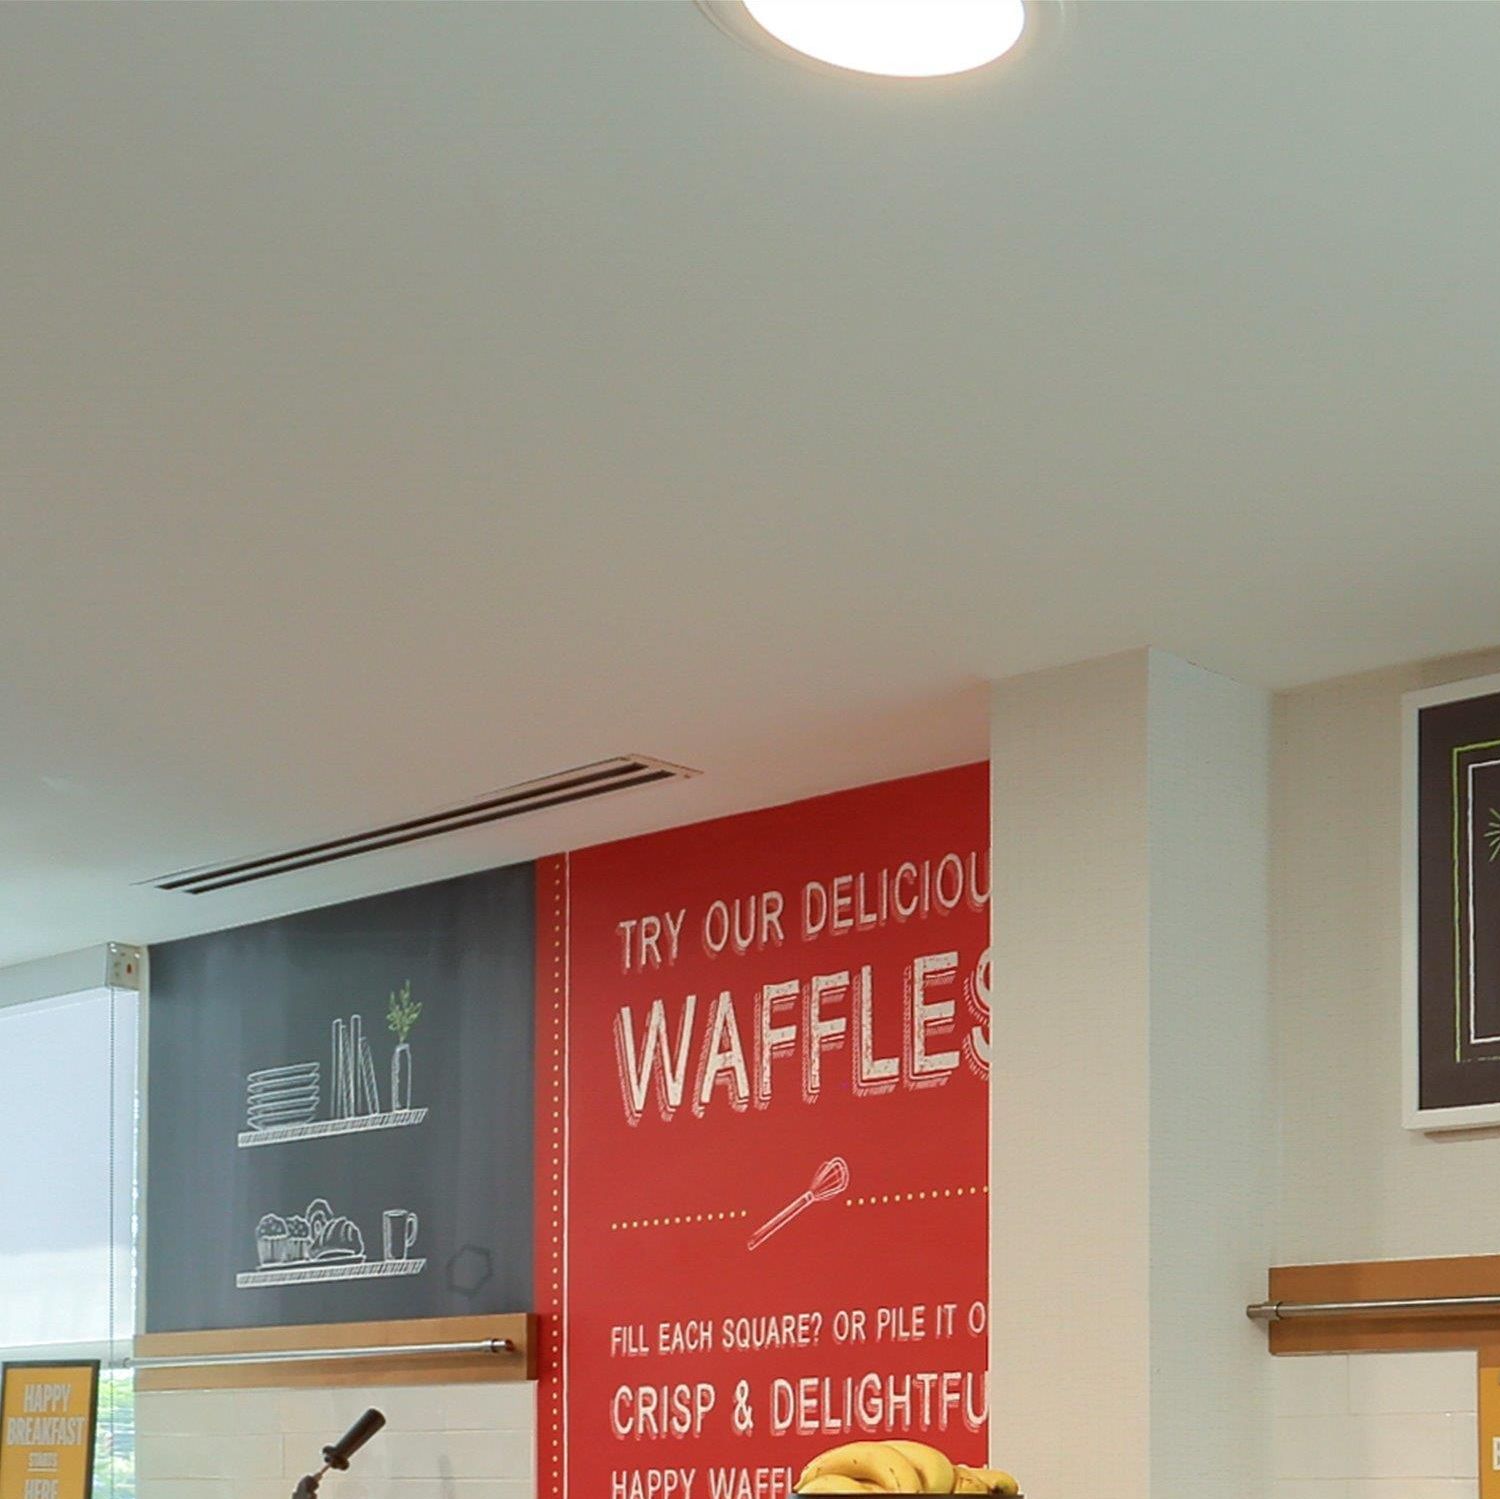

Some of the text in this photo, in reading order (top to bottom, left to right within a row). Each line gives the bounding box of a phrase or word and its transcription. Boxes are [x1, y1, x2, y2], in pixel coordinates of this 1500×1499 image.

[618, 908, 686, 974] TRY
[703, 890, 785, 956] OUR
[610, 1325, 649, 1356] FILL
[658, 1320, 713, 1354] EACH
[722, 1311, 823, 1350] SQUARE?
[832, 1310, 866, 1344] OR
[876, 1305, 926, 1342] PILE
[936, 1304, 957, 1338] IT
[23, 1383, 71, 1412] HAPPY
[611, 1383, 716, 1440] CRISP
[733, 1379, 754, 1435] &
[7, 1416, 85, 1446] BREAKFAST
